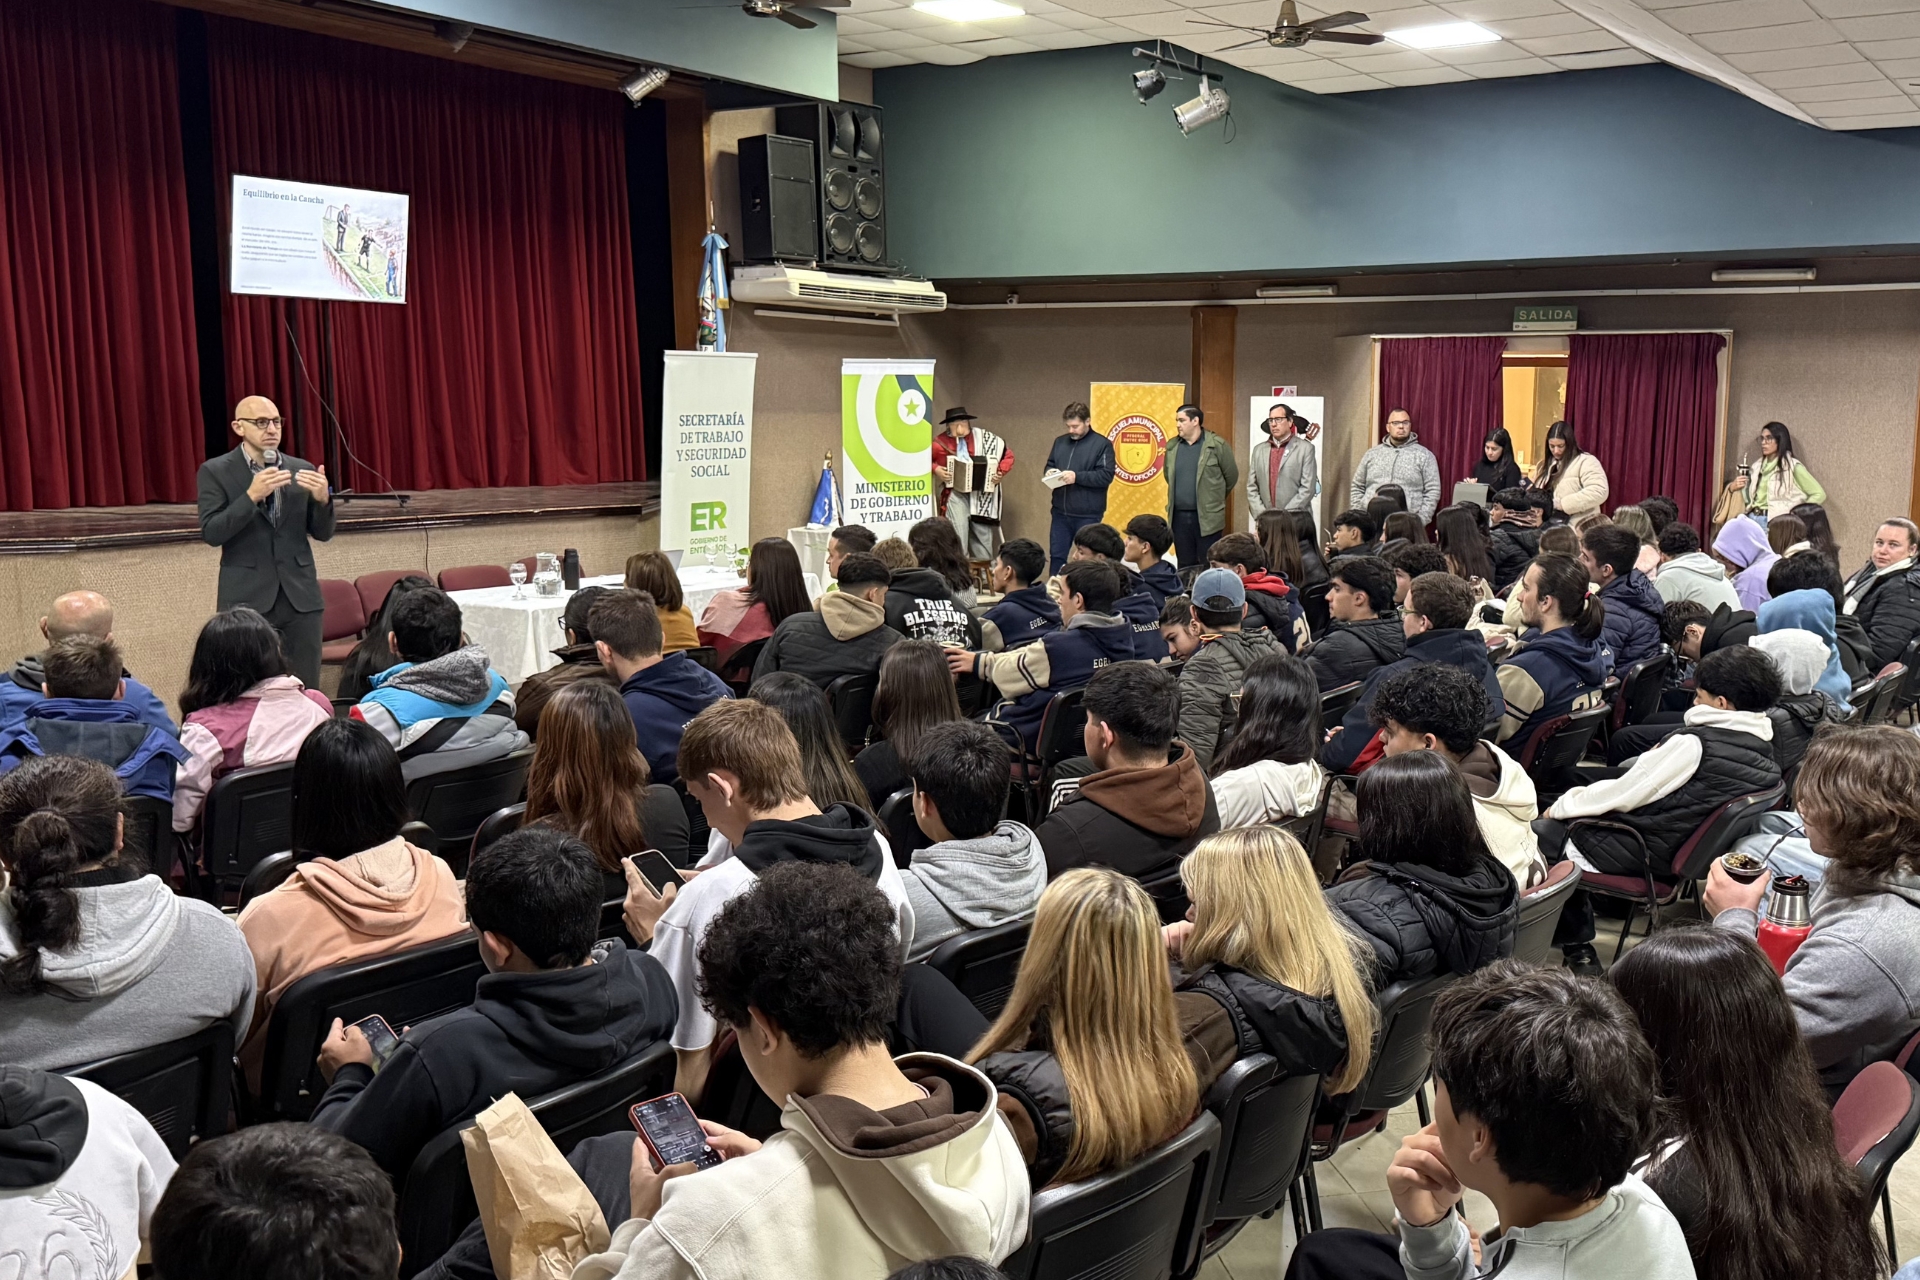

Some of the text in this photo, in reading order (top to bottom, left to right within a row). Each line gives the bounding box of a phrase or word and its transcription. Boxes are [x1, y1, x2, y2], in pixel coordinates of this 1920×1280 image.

[243, 188, 280, 200] Equilibrio
[291, 193, 297, 202] la
[299, 194, 325, 204] Cancha
[1518, 309, 1573, 320] SALIDA
[679, 411, 745, 427] SECRETARÍA
[680, 430, 744, 444] DE TRABAJO
[1107, 416, 1164, 443] ESCUELA MUNICIPAL
[676, 447, 747, 462] Y SEGURIDAD
[691, 464, 730, 478] SOCIAL
[1133, 466, 1157, 481] OFICIOS
[855, 479, 926, 494] MINISTERIO
[850, 494, 930, 510] DE GOBIERNO
[690, 501, 727, 532] ER
[860, 509, 923, 524] Y TRABAJO
[690, 536, 719, 545] GOBIERNO
[914, 598, 954, 611] TRUE
[903, 609, 969, 627] BLESSING
